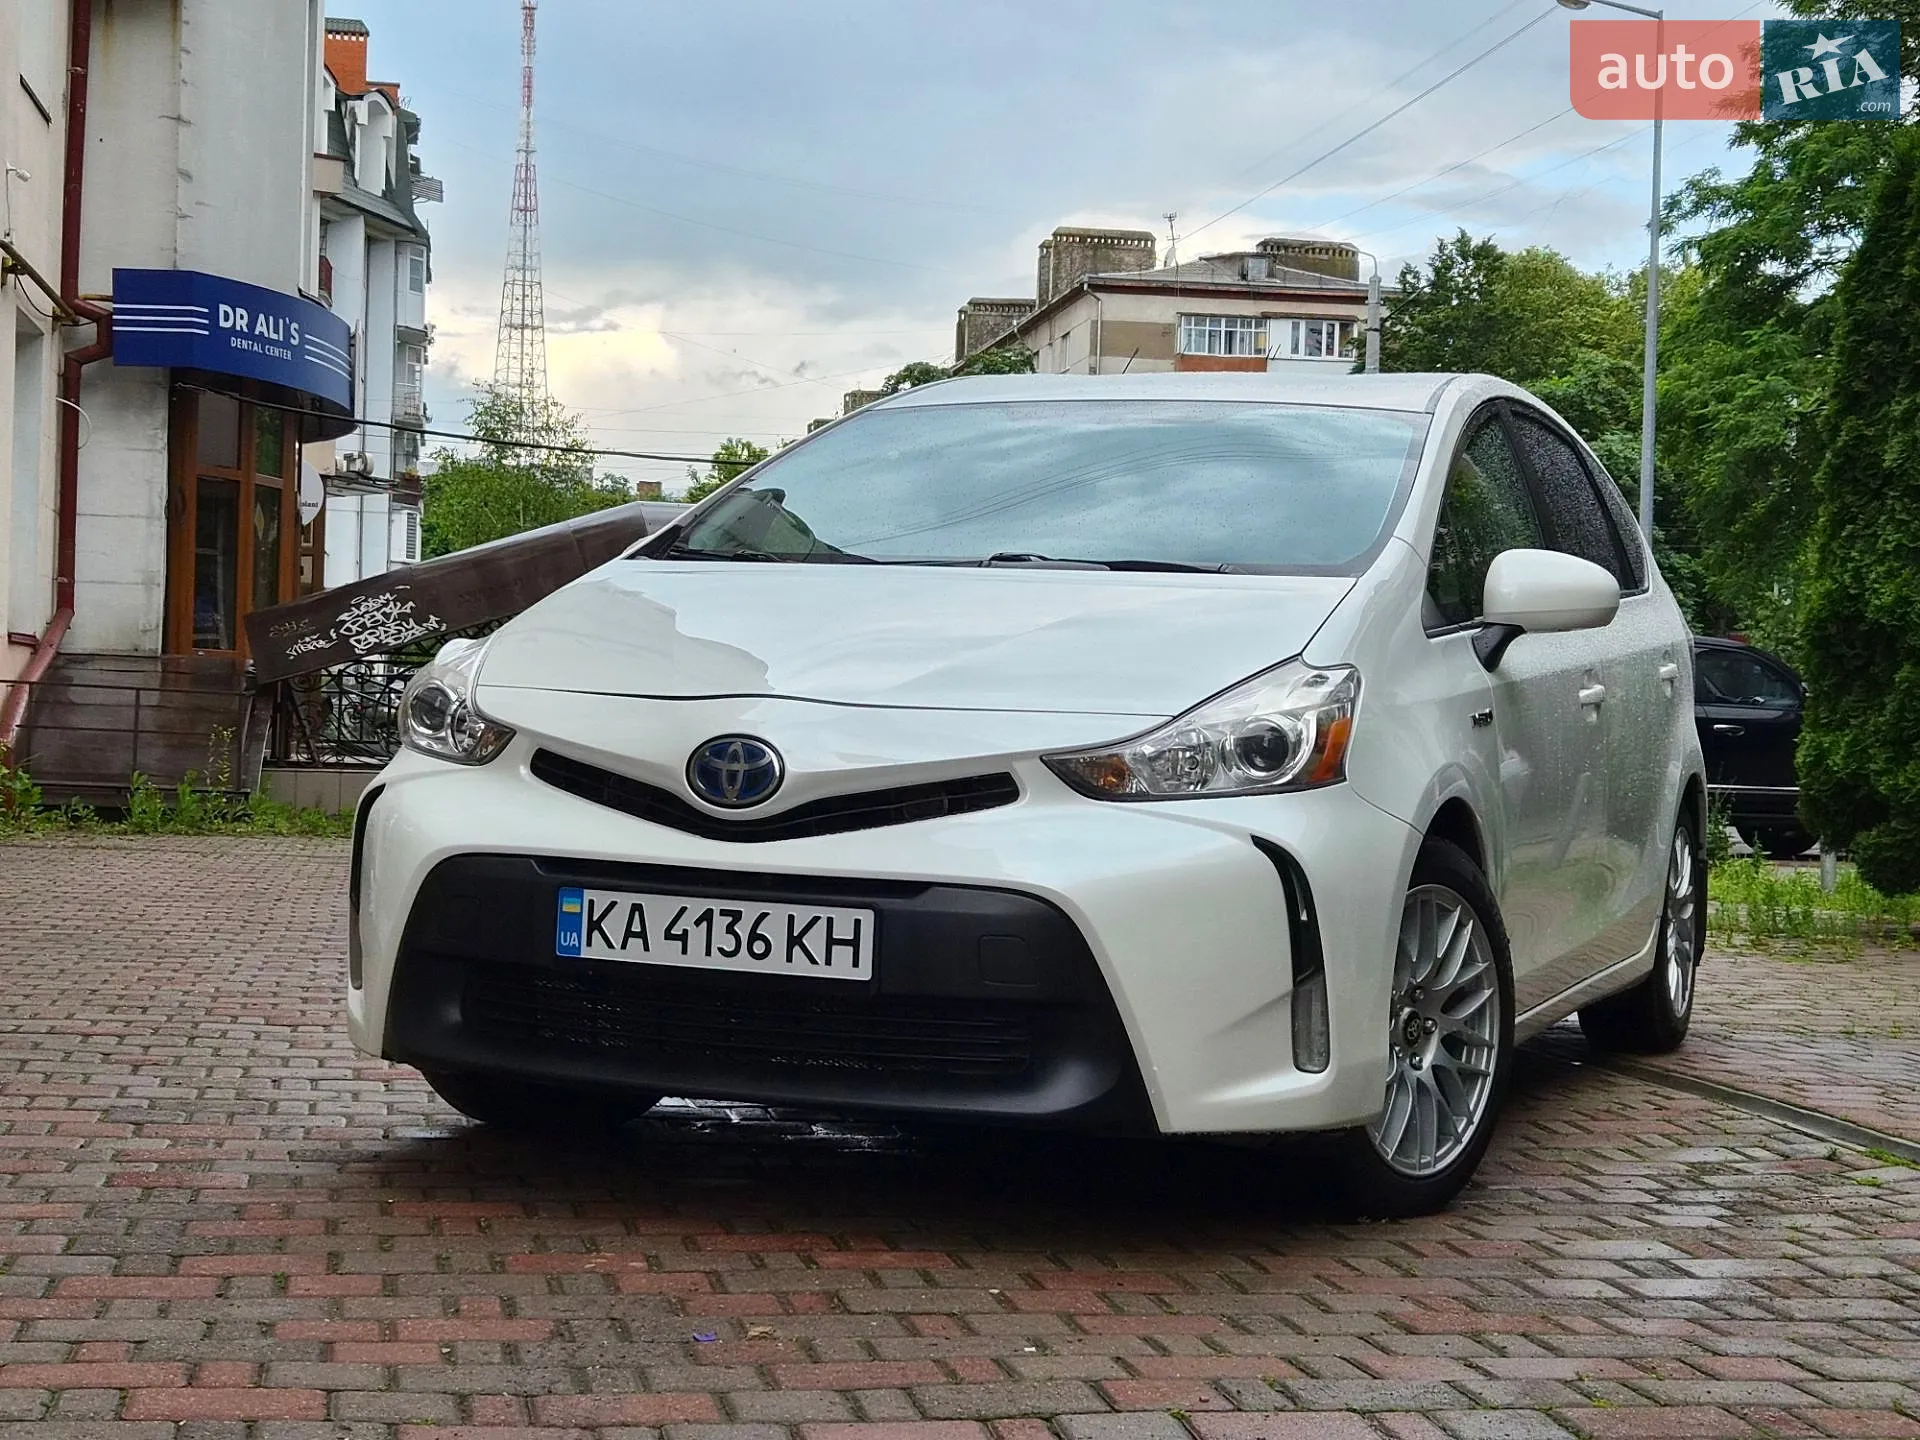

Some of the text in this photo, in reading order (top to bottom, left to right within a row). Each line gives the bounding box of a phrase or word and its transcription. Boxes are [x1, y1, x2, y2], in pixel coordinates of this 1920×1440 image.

[218, 303, 248, 333] DR
[231, 336, 293, 361] DENTAL CENTER
[560, 930, 579, 948] UA
[585, 898, 862, 968] KA 4136 KH
